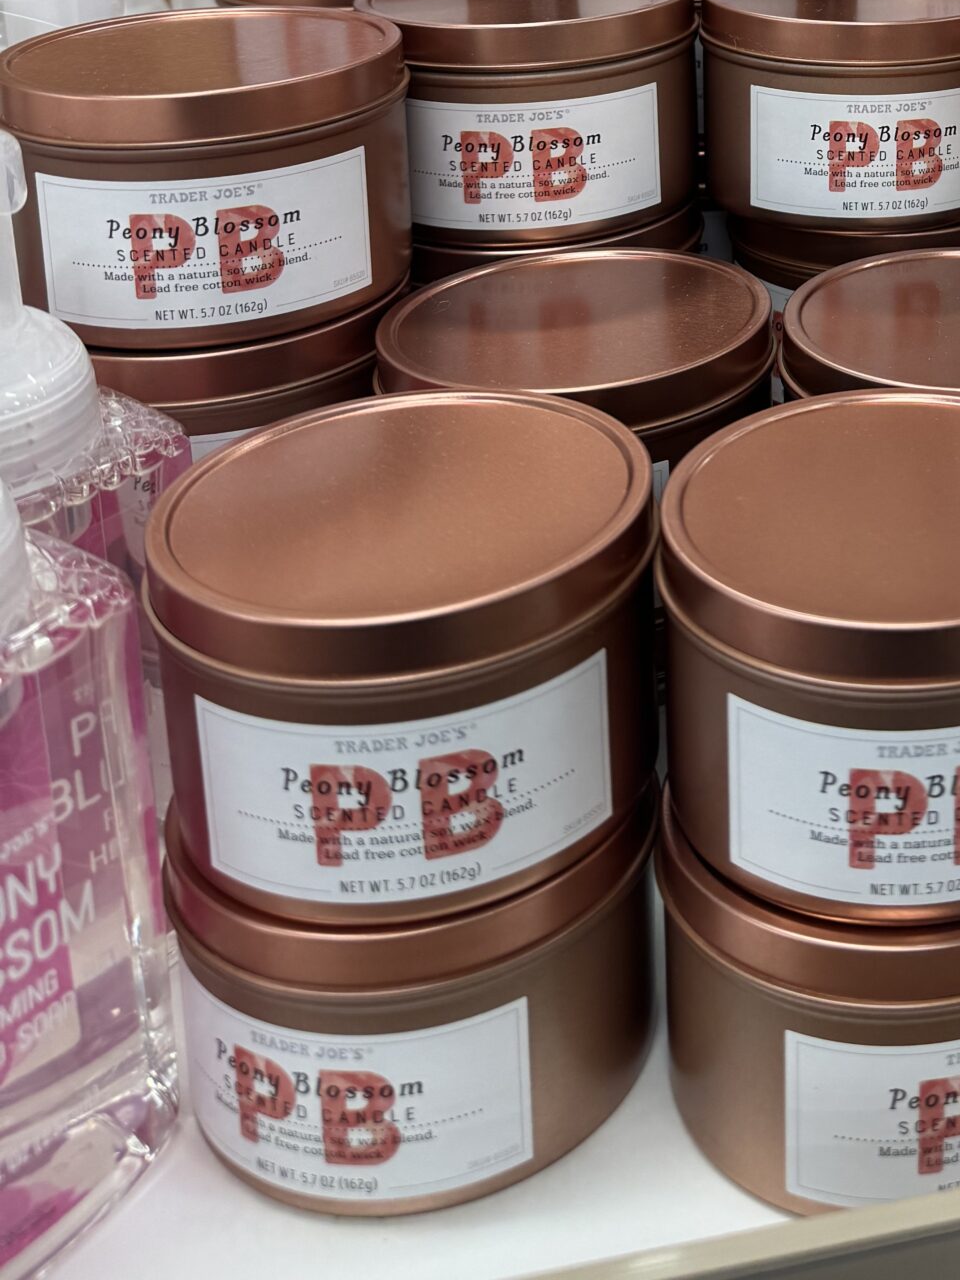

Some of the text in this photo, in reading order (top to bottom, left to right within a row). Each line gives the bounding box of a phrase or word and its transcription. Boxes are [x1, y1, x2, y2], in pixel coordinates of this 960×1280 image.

[476, 112, 526, 123] TRADER
[846, 103, 893, 114] TRADER
[441, 133, 602, 161] Peony Blossom
[810, 124, 957, 151] Peony Blossom
[449, 152, 597, 171] SCENTED CANDLE
[816, 143, 952, 161] SCENTED CANDLE
[149, 190, 209, 205] TRADER
[106, 209, 302, 248] Peony Blossom
[116, 232, 296, 262] SCENTED CANDLE
[104, 251, 312, 282] Made with a natural soy wax blend.
[142, 283, 171, 294] Lead
[174, 283, 200, 293] free
[202, 278, 241, 291] cotton
[155, 298, 268, 321] NET WT. 5.7 OZ (162g)
[280, 747, 526, 807] Peony Blossom
[293, 776, 518, 821] SCENTED CANDLE
[819, 770, 911, 811] Peony
[829, 807, 939, 825] SCENTED
